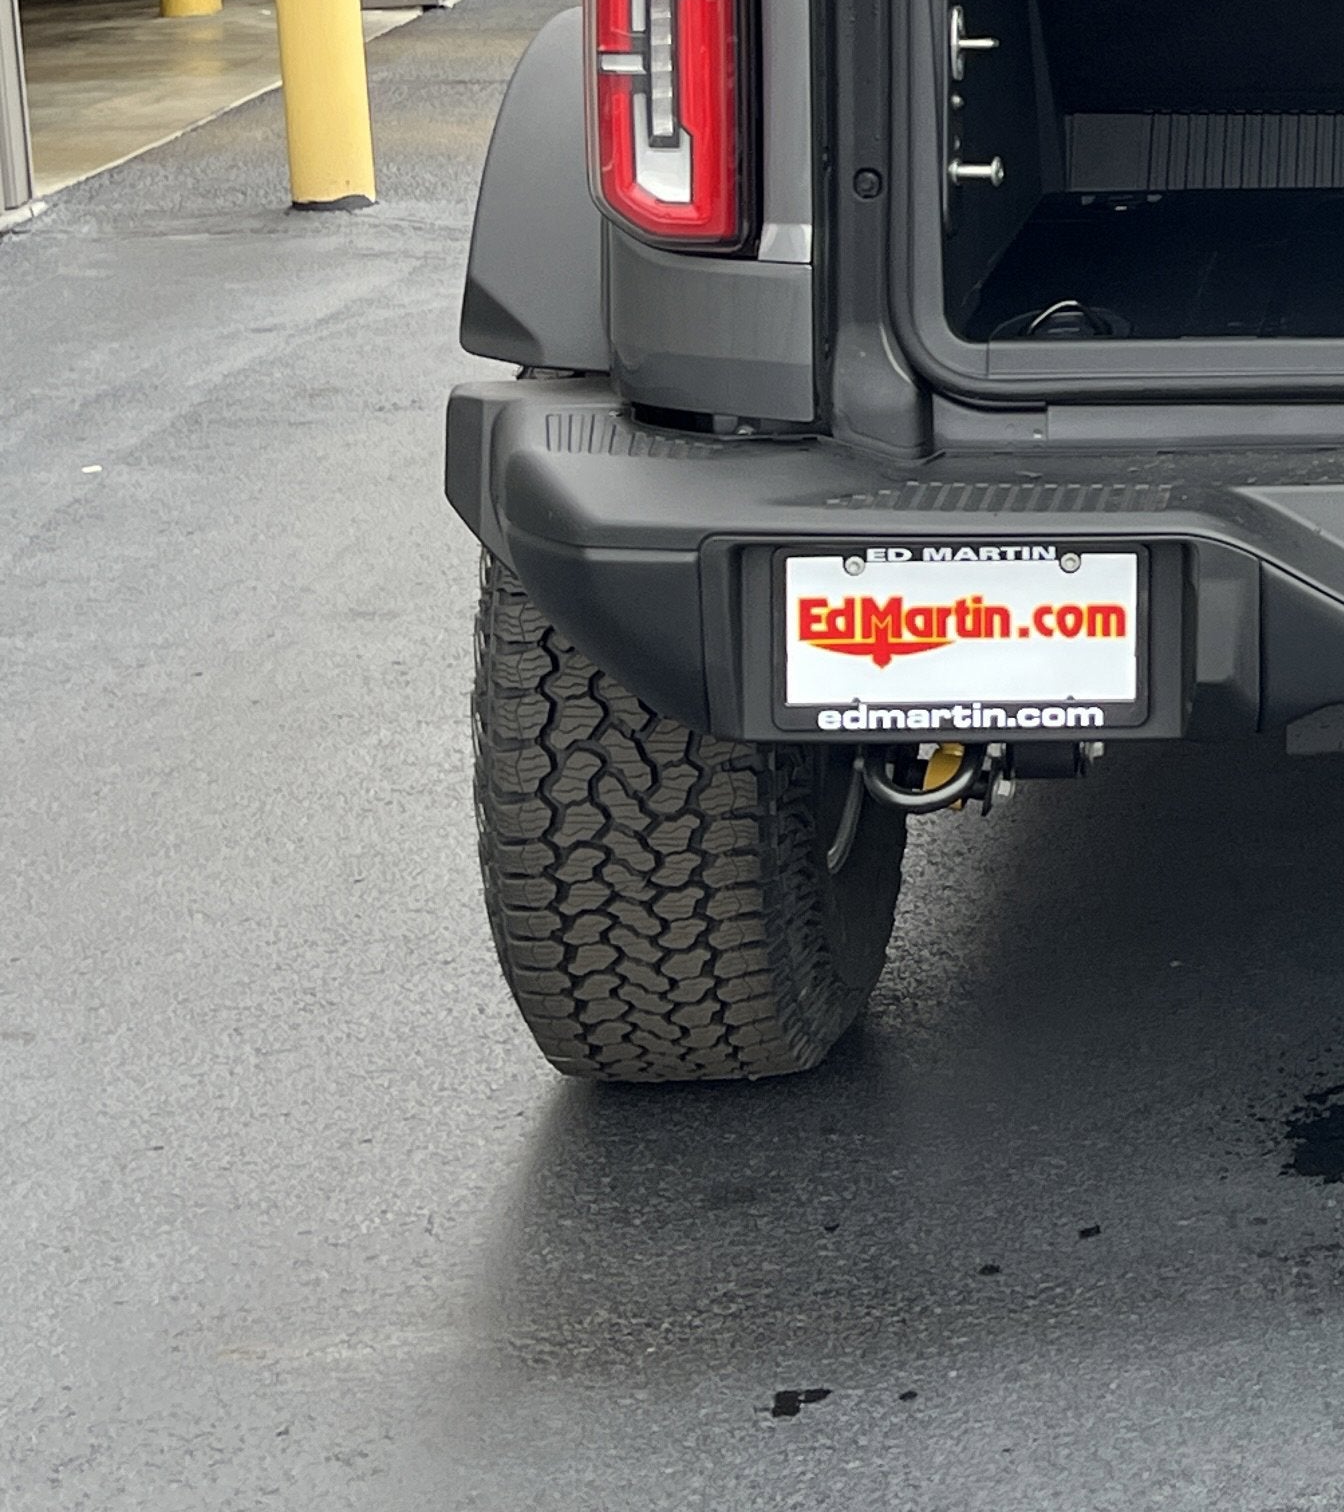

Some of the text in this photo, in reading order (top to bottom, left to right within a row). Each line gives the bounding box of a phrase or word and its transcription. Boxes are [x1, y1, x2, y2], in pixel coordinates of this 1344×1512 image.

[866, 546, 1057, 562] ED MARTIN
[816, 703, 1105, 730] edmartin.com
